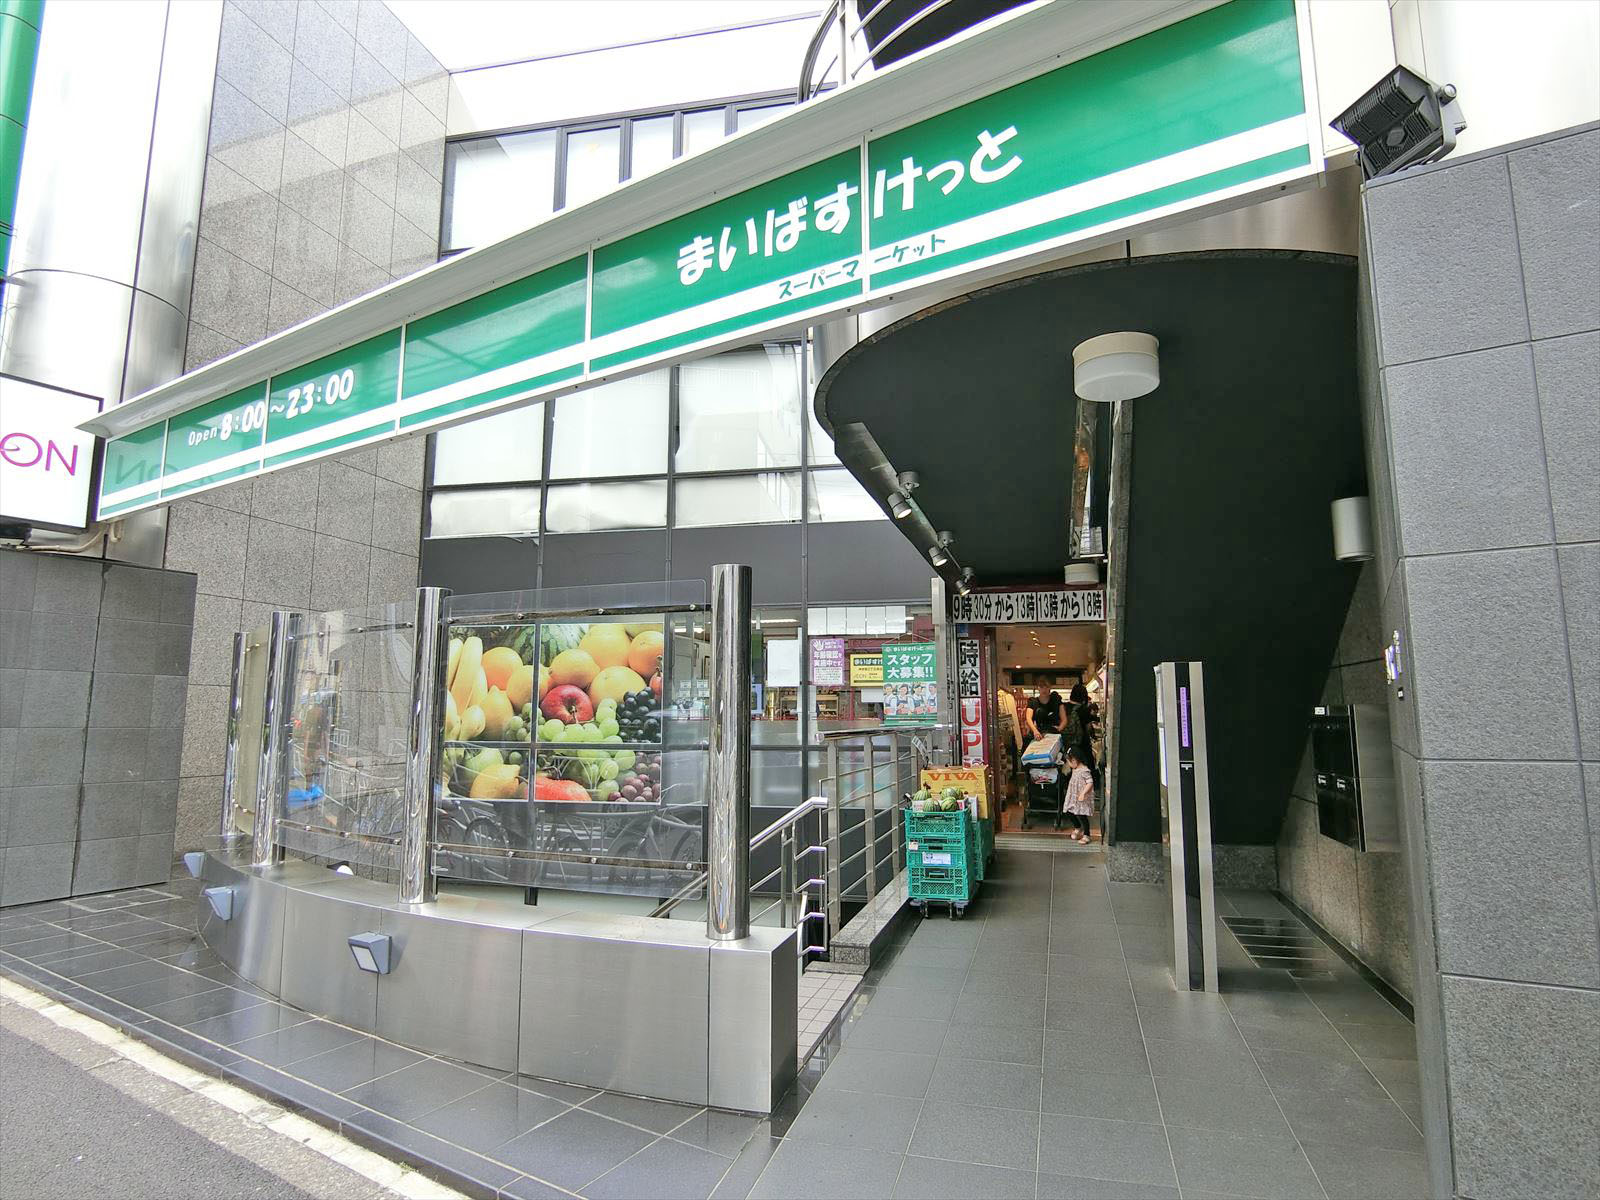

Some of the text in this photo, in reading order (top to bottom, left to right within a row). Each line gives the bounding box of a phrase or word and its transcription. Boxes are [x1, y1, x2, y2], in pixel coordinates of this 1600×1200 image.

[676, 125, 1024, 286] まいばすけっと
[778, 233, 946, 299] スーパーマーケット
[188, 427, 217, 446] Open
[887, 653, 933, 665] スタッフ
[887, 666, 933, 679] 大募集!!
[927, 772, 977, 781] VIVA
